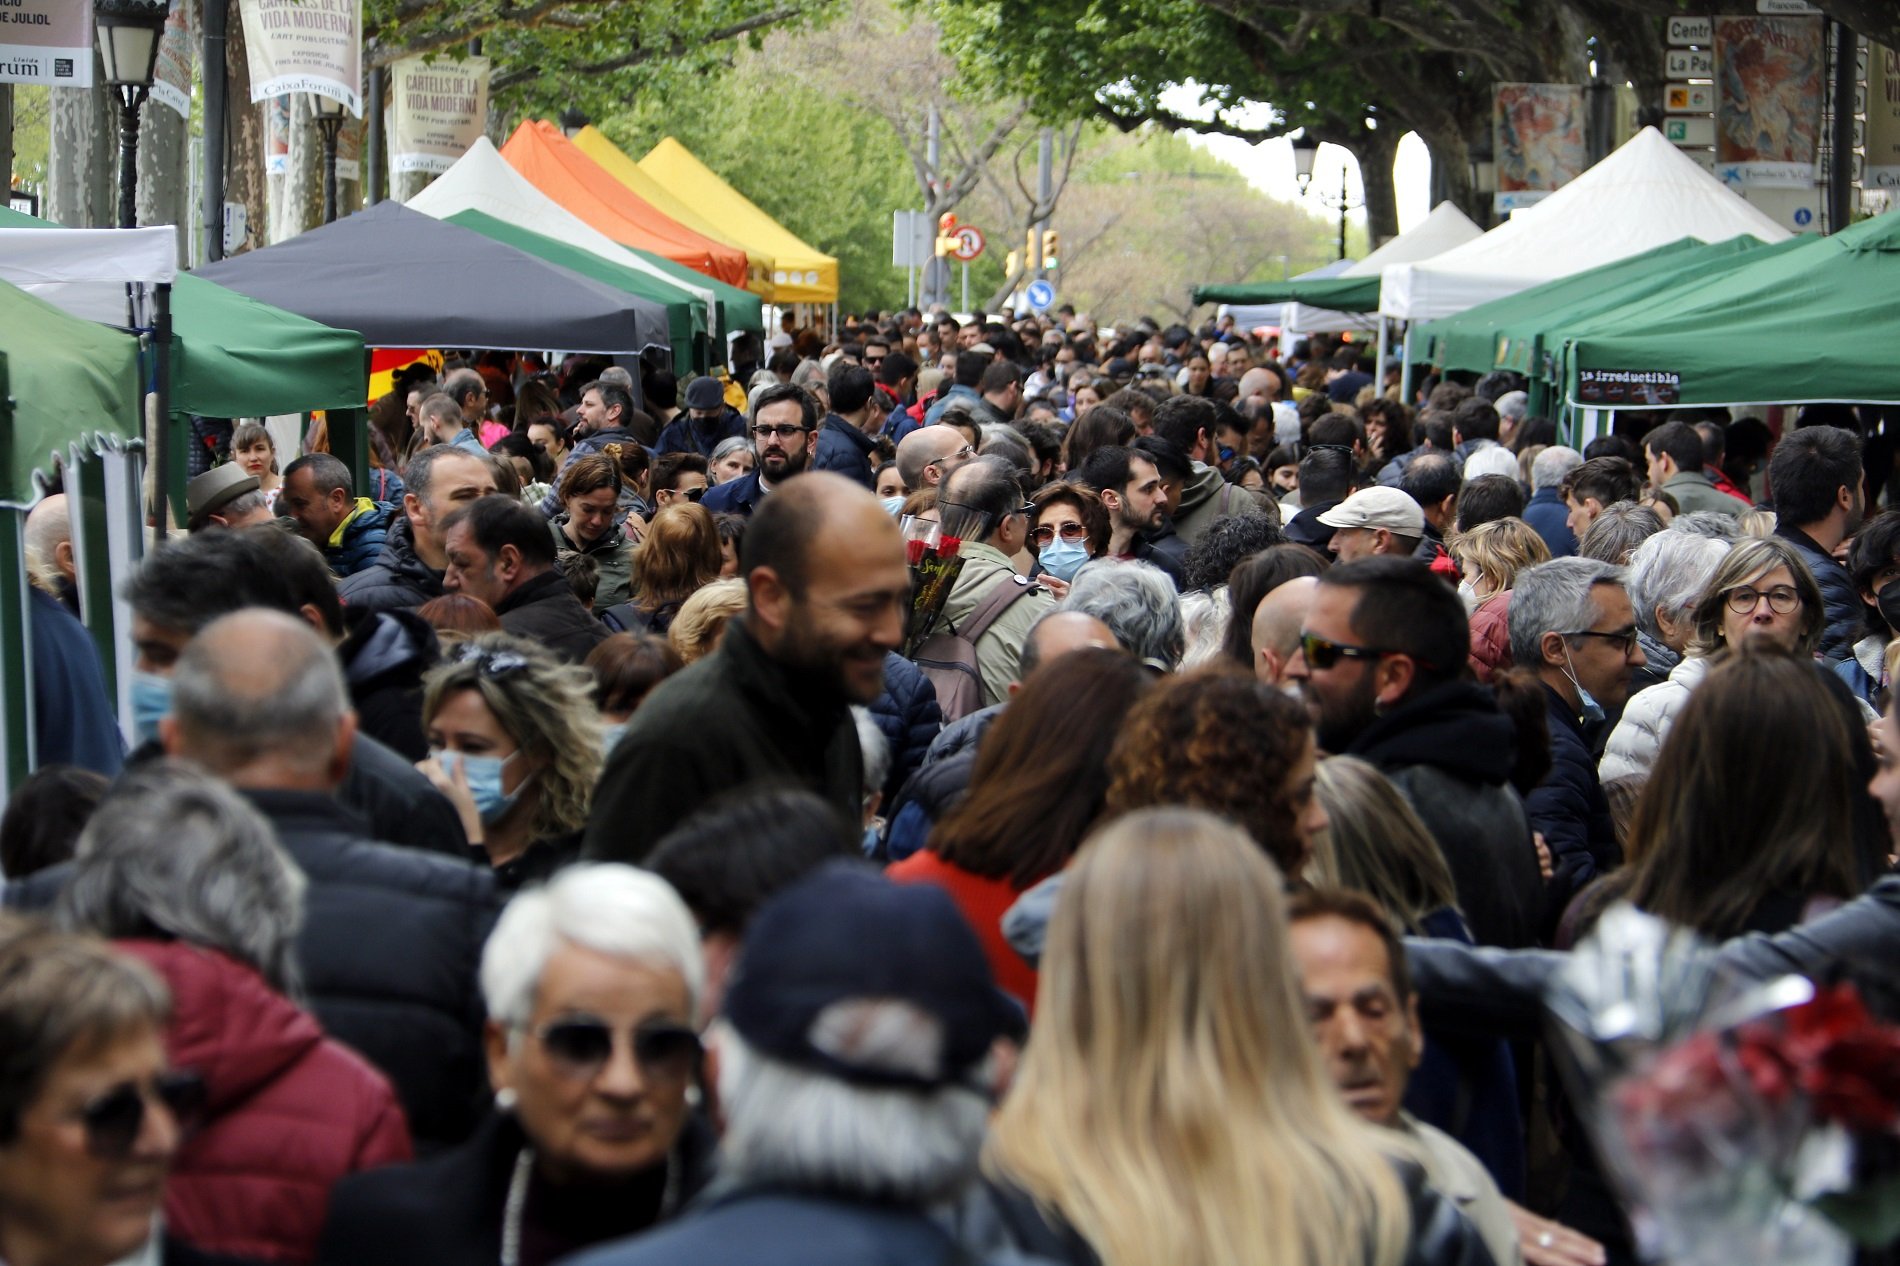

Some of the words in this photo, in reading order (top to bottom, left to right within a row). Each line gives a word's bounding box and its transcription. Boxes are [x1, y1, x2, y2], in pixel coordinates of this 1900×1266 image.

[11, 12, 51, 26] JULIOL
[260, 11, 290, 31] VIDA
[293, 10, 353, 38] MODERNA
[1670, 57, 1686, 71] La
[264, 78, 343, 99] CaixaForum
[406, 74, 451, 95] CARTELLS
[453, 76, 465, 95] DE
[467, 78, 478, 97] LA
[406, 93, 428, 111] VIDA
[431, 95, 477, 115] MODERNA
[1595, 370, 1679, 384] irreductible
